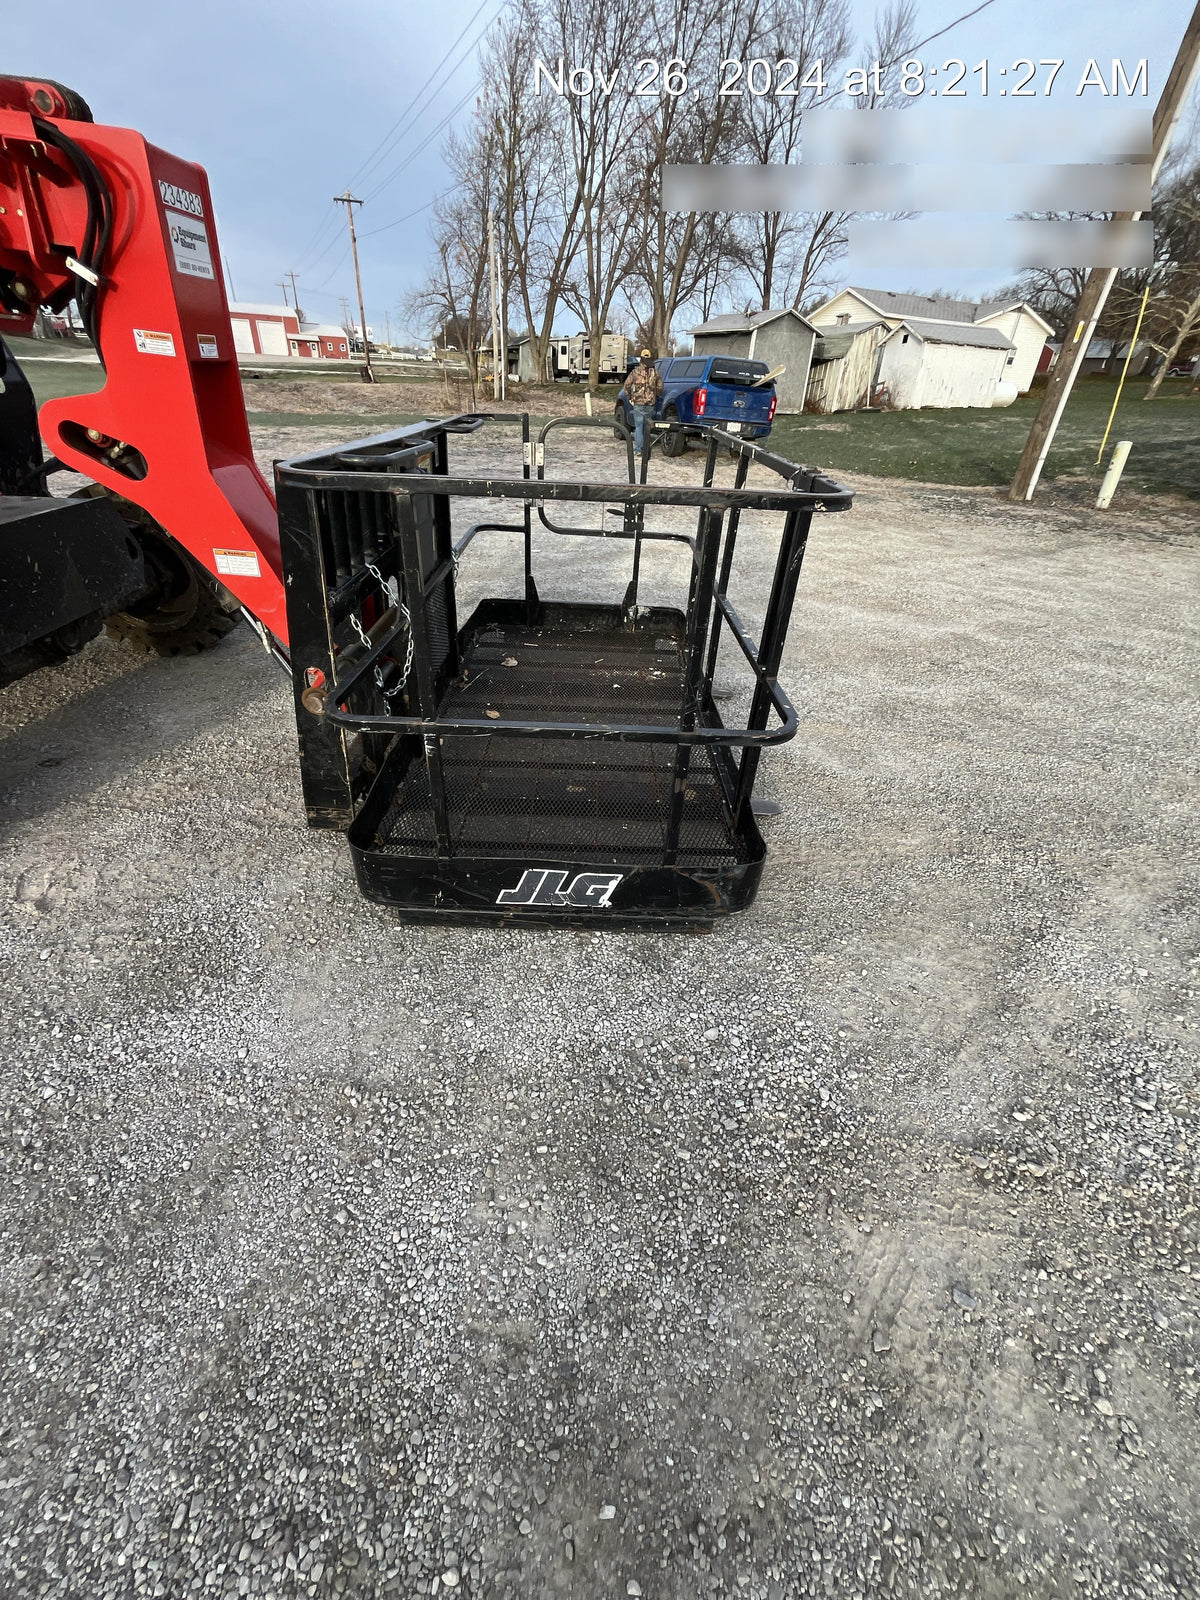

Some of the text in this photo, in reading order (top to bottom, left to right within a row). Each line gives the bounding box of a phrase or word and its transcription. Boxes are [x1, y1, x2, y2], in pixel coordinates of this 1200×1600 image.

[160, 181, 203, 215] 234383
[177, 226, 207, 243] Equipment
[180, 238, 197, 251] Share
[495, 868, 624, 908] JLG
